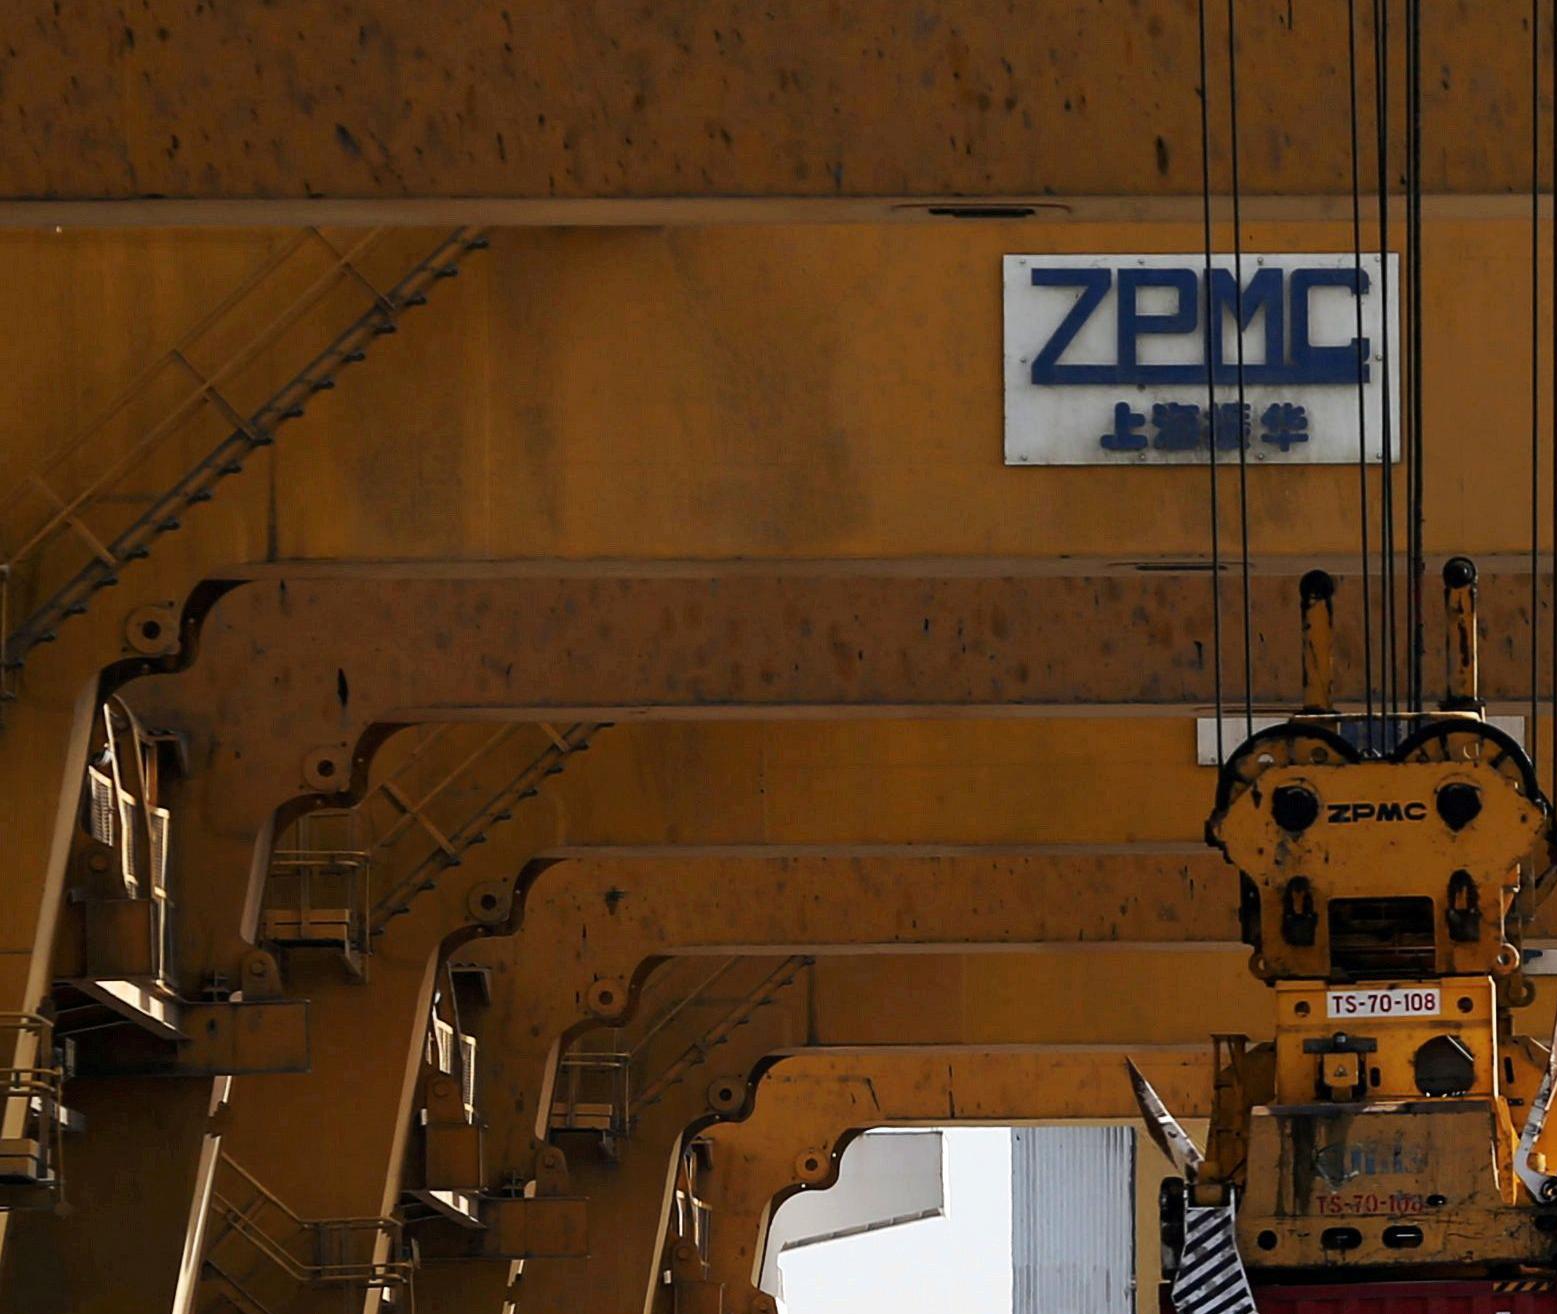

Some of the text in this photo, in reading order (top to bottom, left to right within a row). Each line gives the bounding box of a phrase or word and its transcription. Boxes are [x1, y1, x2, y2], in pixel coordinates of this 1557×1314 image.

[1031, 267, 1370, 384] ZPMC
[1328, 802, 1427, 823] ZPMC
[1332, 993, 1435, 1013] TS-70-108
